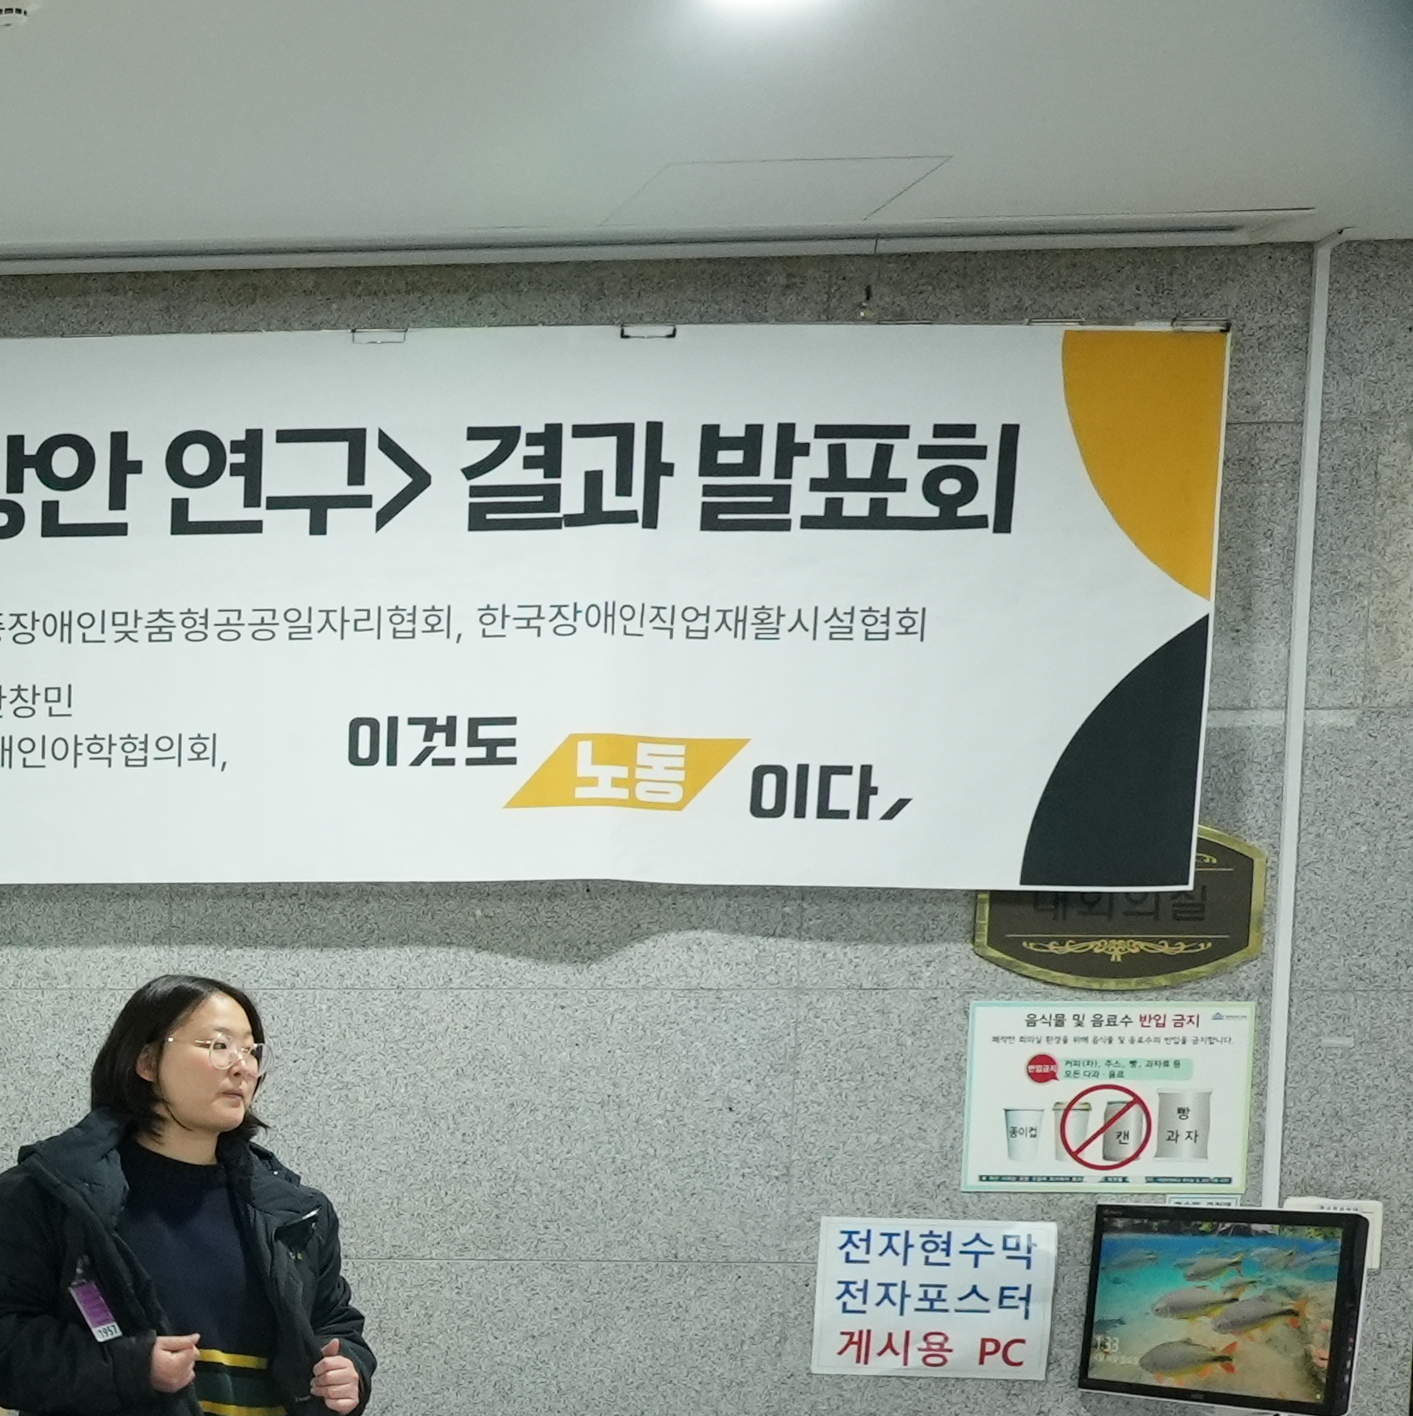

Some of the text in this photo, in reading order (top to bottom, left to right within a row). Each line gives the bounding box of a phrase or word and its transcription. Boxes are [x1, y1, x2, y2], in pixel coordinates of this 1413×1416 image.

[165, 428, 431, 535] 연구>
[461, 421, 674, 531] 결과
[699, 423, 1020, 533] 발표회
[478, 601, 926, 642] 한국장애인직업재활시설협회
[348, 716, 517, 766] 이것도
[575, 739, 687, 804] 노동
[1025, 1013, 1200, 1028] 음식물 및 음료수 반입 금지
[838, 1227, 1038, 1268] 전자현수막
[835, 1280, 1032, 1320] 전자포스터
[838, 1329, 1026, 1367] 게시용 PC
